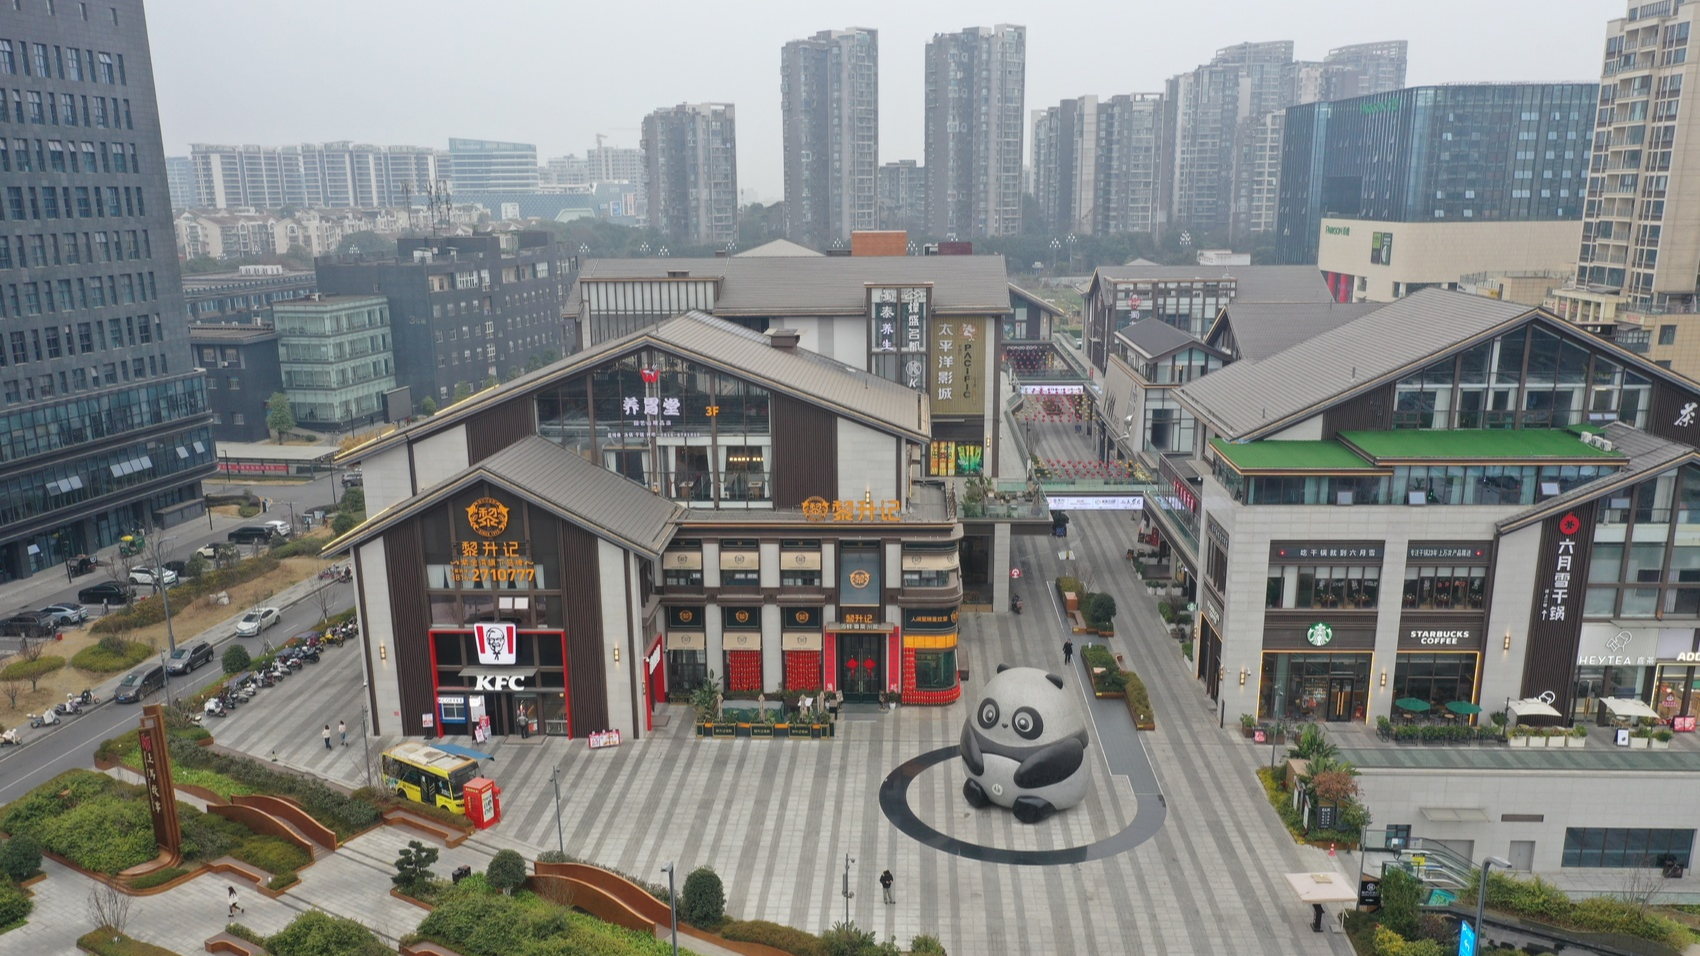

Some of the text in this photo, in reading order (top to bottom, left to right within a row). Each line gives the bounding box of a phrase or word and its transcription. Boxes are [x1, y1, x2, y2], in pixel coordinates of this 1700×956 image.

[938, 323, 954, 400] 太平洋影城
[963, 344, 972, 399] PACIFIC
[705, 406, 719, 417] 3F
[832, 499, 902, 522] 黎升记
[461, 541, 519, 557] 黎升记
[472, 568, 535, 582] 2710777
[1549, 538, 1575, 621] 六月雪干锅
[1410, 630, 1469, 638] STARBUCKS
[1420, 637, 1458, 645] COFFEE
[1579, 656, 1631, 665] HEYTEA
[474, 675, 525, 691] KFC
